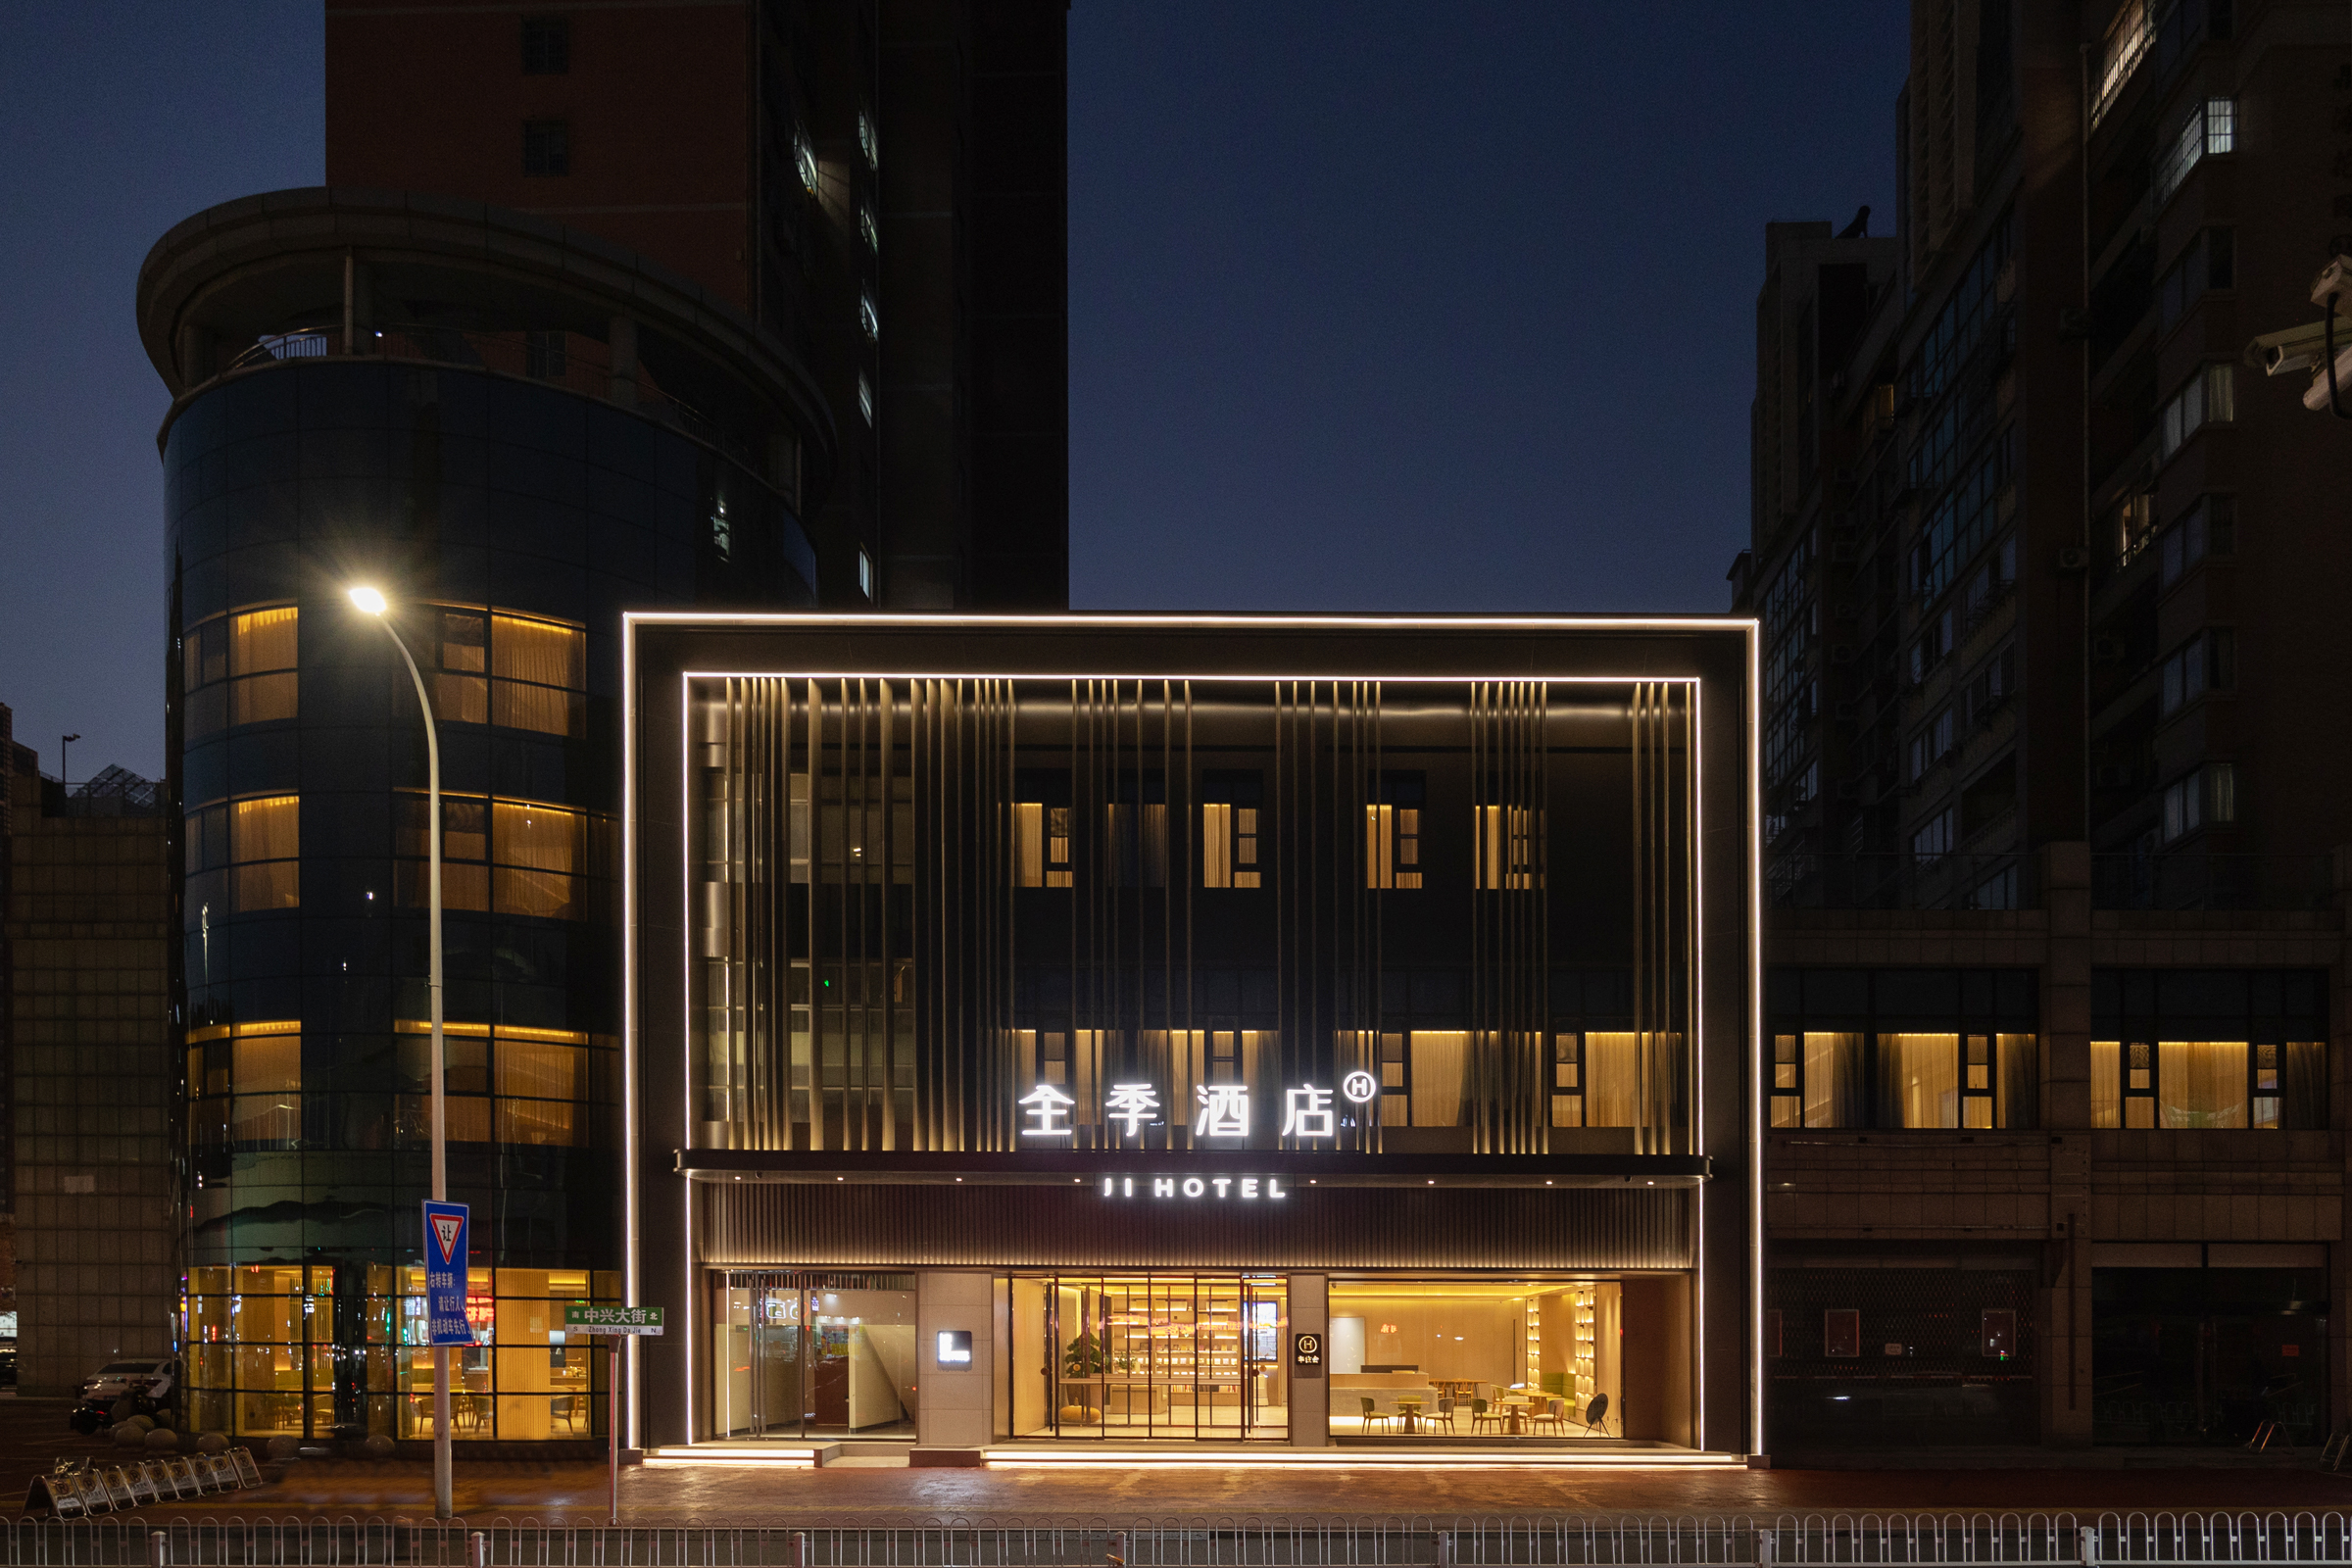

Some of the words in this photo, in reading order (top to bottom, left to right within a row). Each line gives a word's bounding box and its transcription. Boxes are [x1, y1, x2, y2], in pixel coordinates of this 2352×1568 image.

[1018, 1083, 1334, 1138] 全季酒店
[1103, 1178, 1133, 1198] JI
[1154, 1178, 1287, 1199] HOTEL
[441, 1224, 451, 1242] 让
[584, 1307, 647, 1324] 中兴大街
